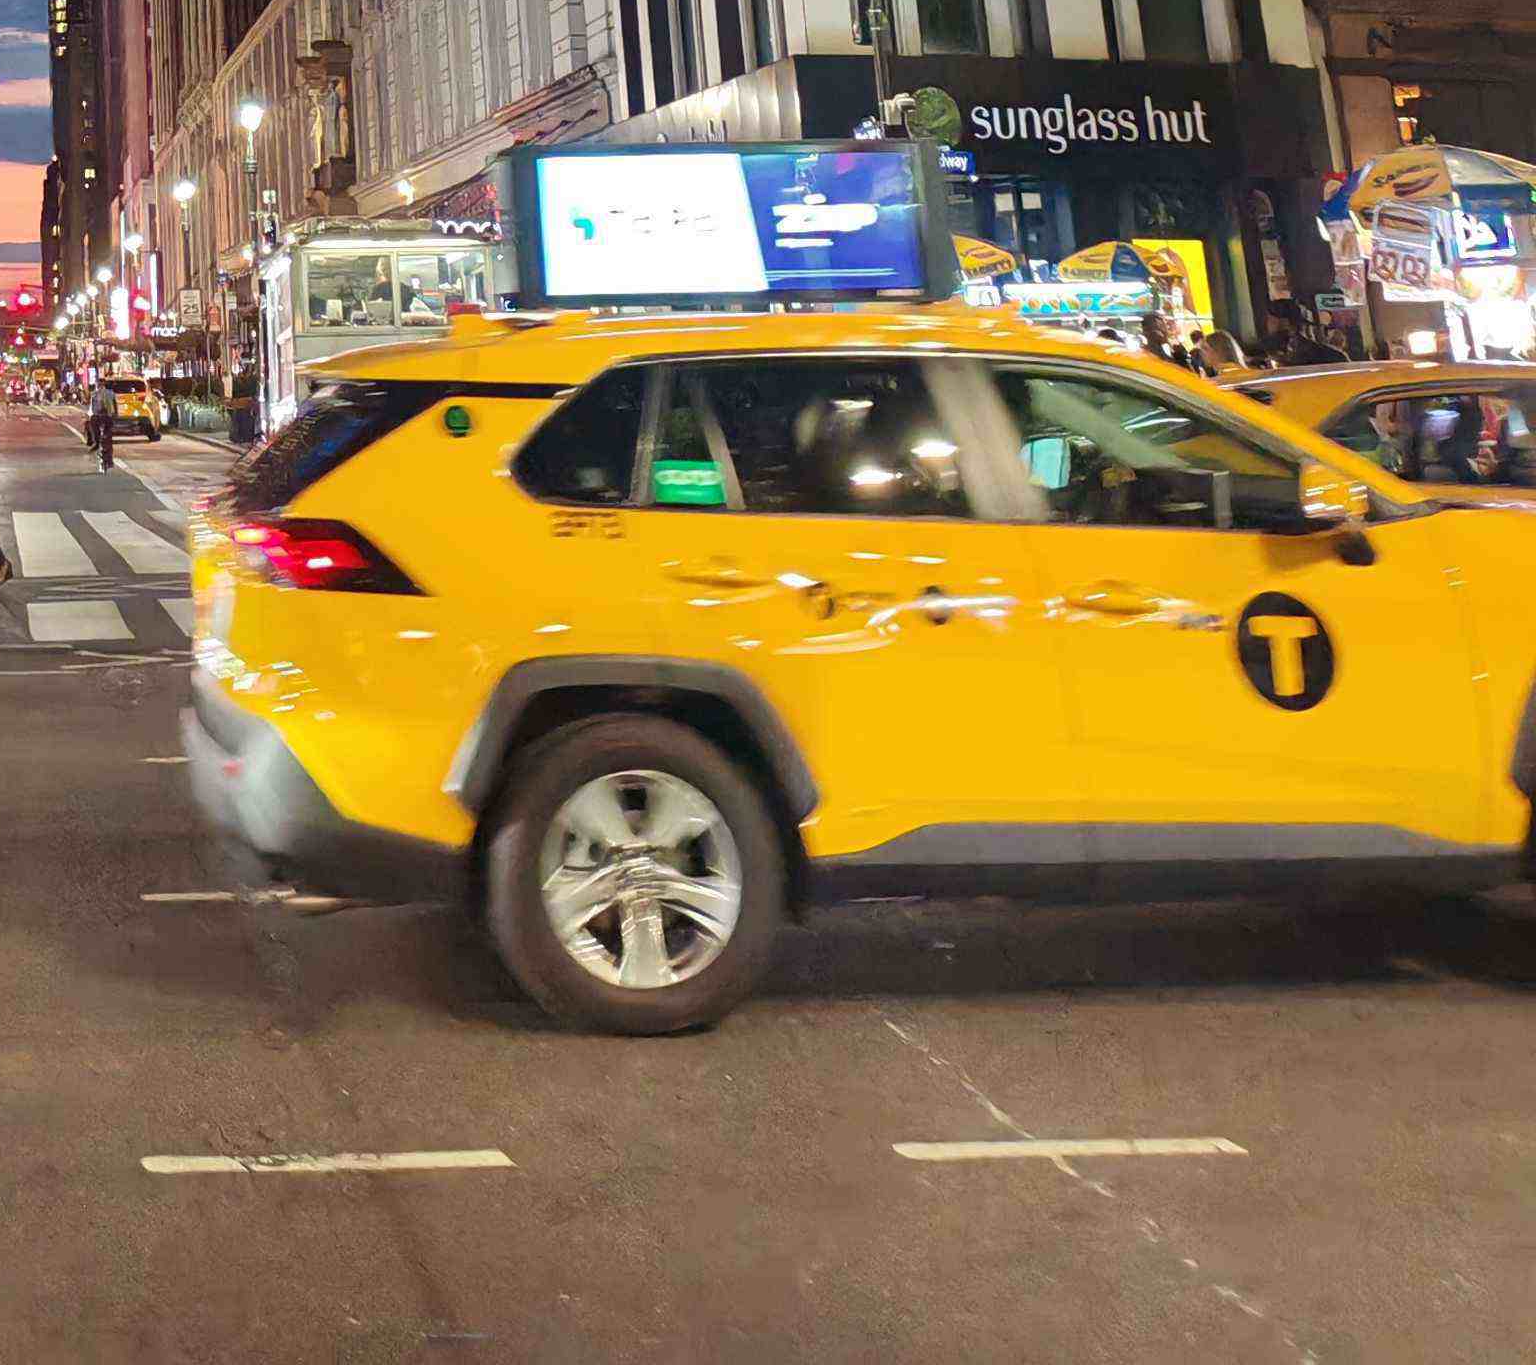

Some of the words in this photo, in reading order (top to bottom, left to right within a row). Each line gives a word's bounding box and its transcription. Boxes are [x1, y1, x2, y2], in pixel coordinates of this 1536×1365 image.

[970, 93, 1140, 155] sunglass
[1144, 95, 1212, 144] hut
[183, 303, 200, 315] 25
[1246, 615, 1319, 697] T
